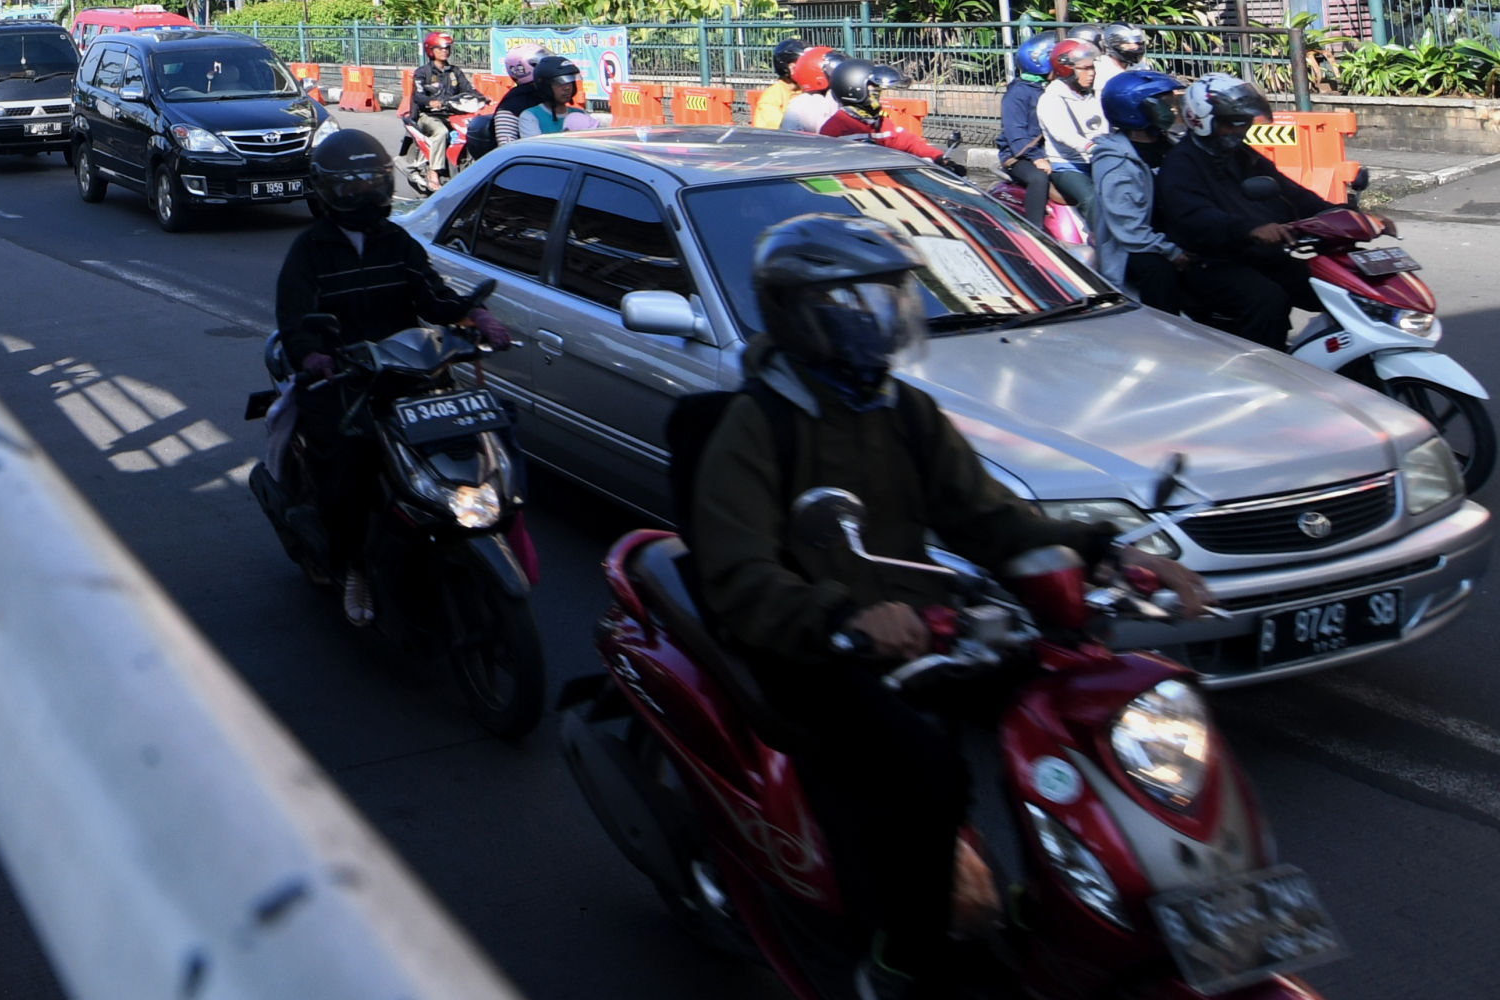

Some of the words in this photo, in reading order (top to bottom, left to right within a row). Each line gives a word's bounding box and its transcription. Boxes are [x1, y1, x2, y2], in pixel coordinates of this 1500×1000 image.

[252, 183, 259, 195] B
[266, 182, 284, 193] 1959
[404, 408, 418, 423] B
[417, 400, 460, 420] 3405
[458, 394, 490, 413] TAT
